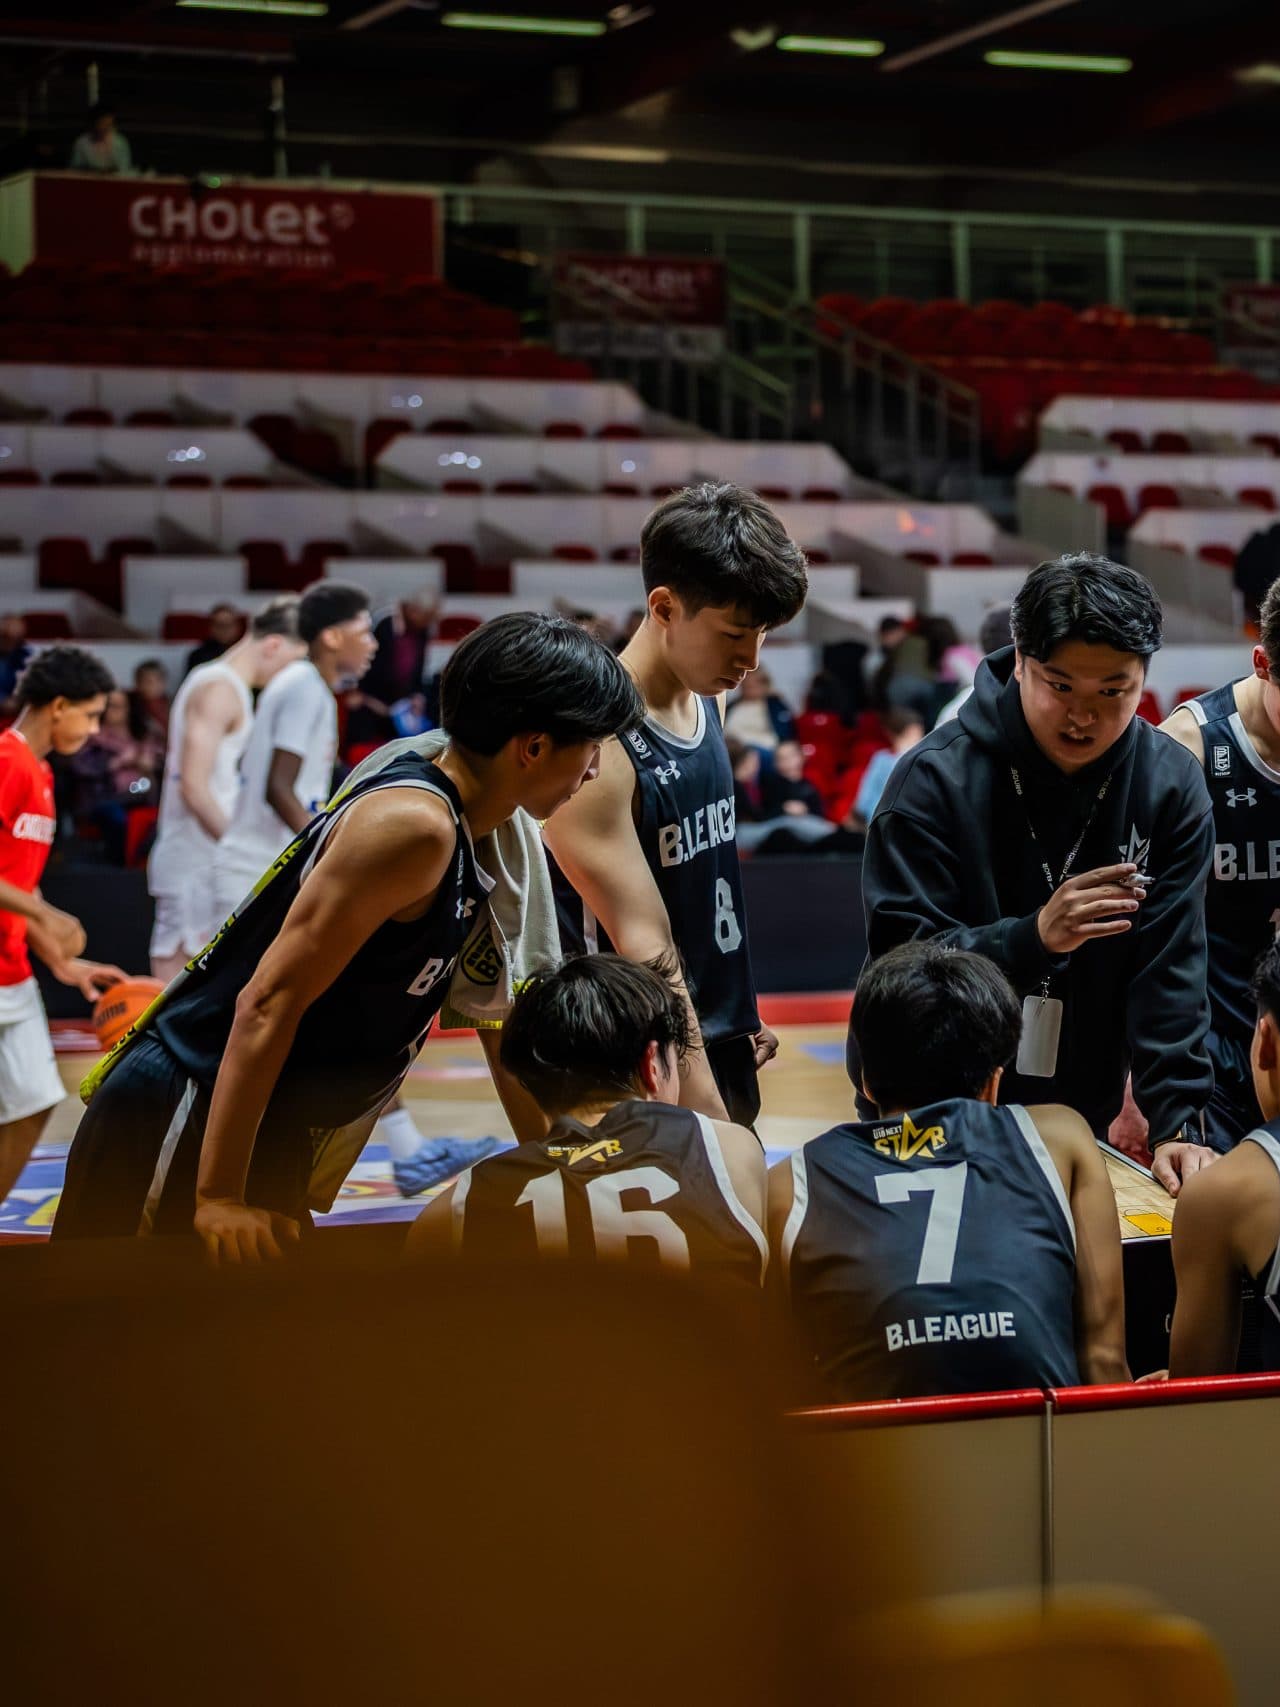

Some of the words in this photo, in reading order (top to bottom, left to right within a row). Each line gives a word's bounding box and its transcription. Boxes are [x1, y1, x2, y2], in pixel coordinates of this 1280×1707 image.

[714, 877, 743, 954] 8
[513, 1166, 691, 1272] 16
[874, 1160, 969, 1286] 7
[884, 1311, 1017, 1353] B.LEAGUE
